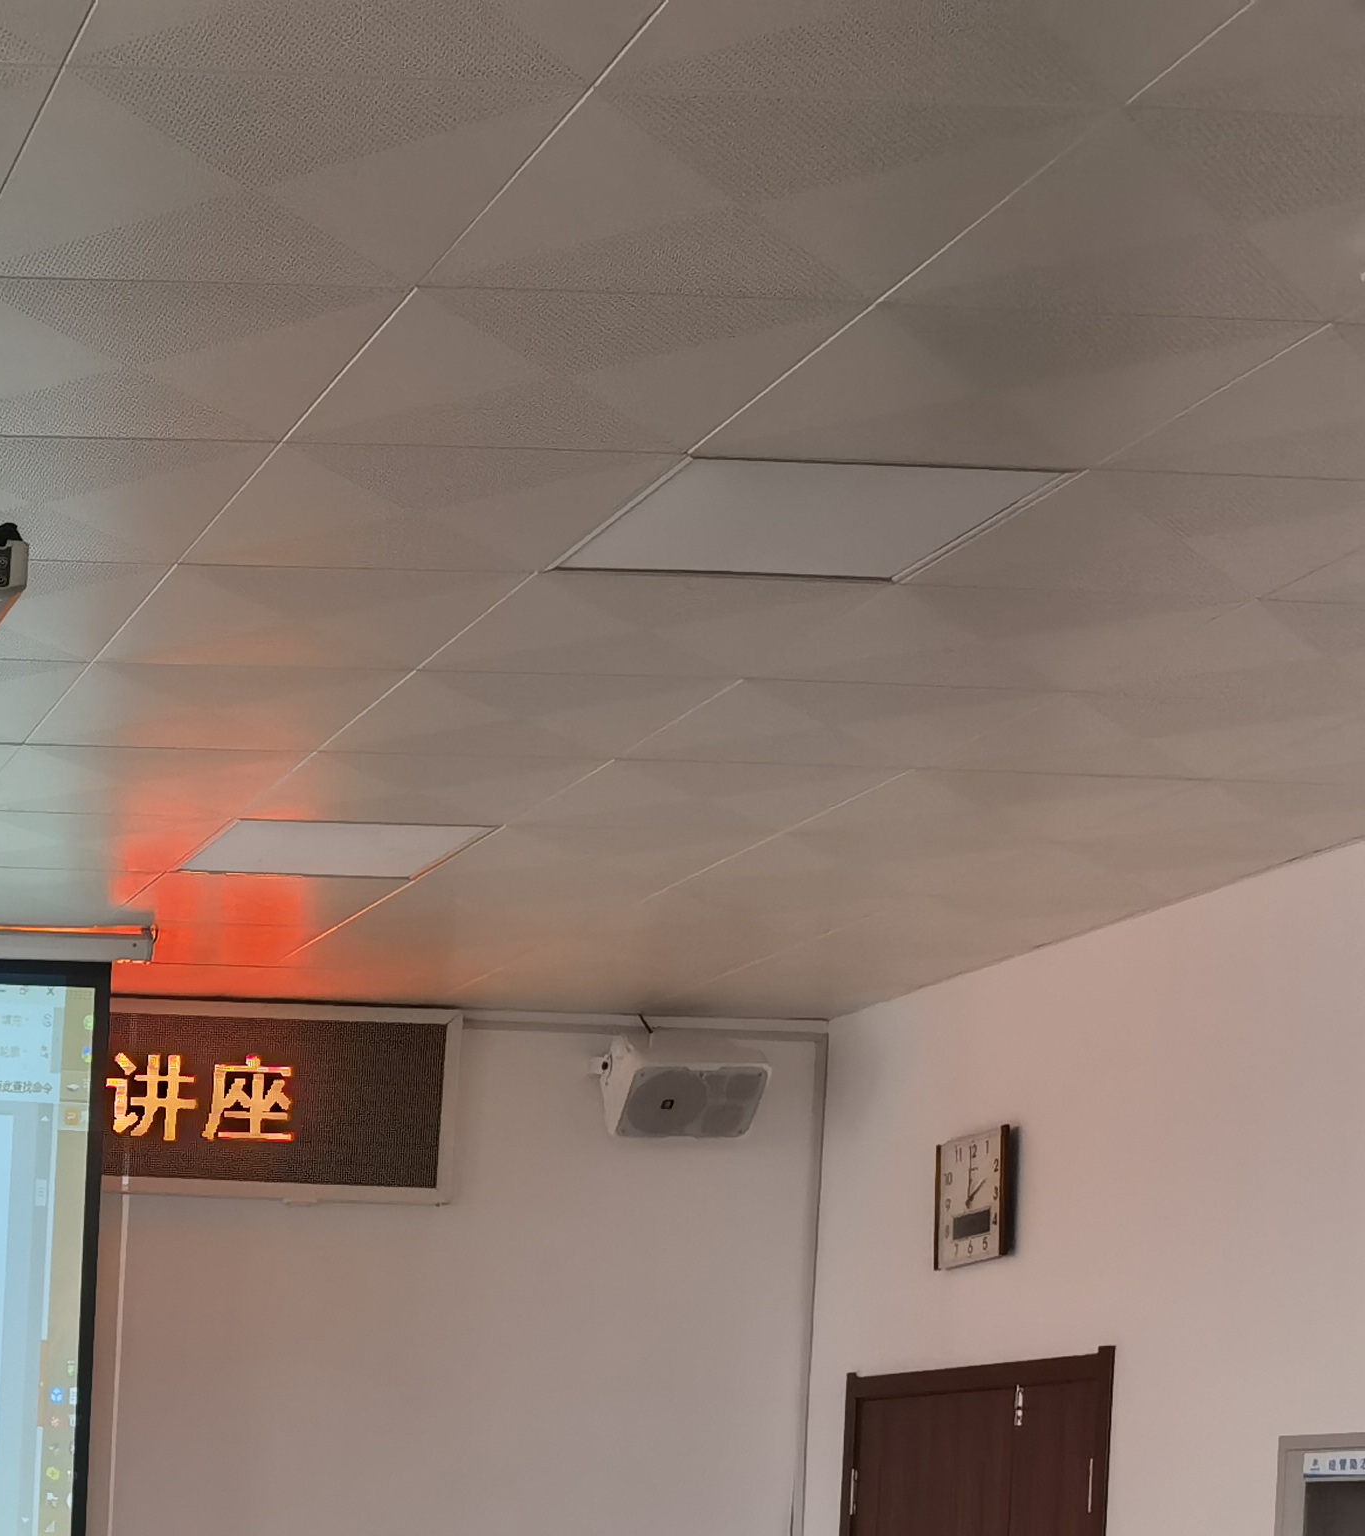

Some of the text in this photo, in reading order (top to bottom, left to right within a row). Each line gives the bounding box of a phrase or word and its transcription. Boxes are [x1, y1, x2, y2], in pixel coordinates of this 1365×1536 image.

[106, 1052, 295, 1142] 讲座
[955, 1145, 963, 1163] 11
[943, 1172, 953, 1186] 10
